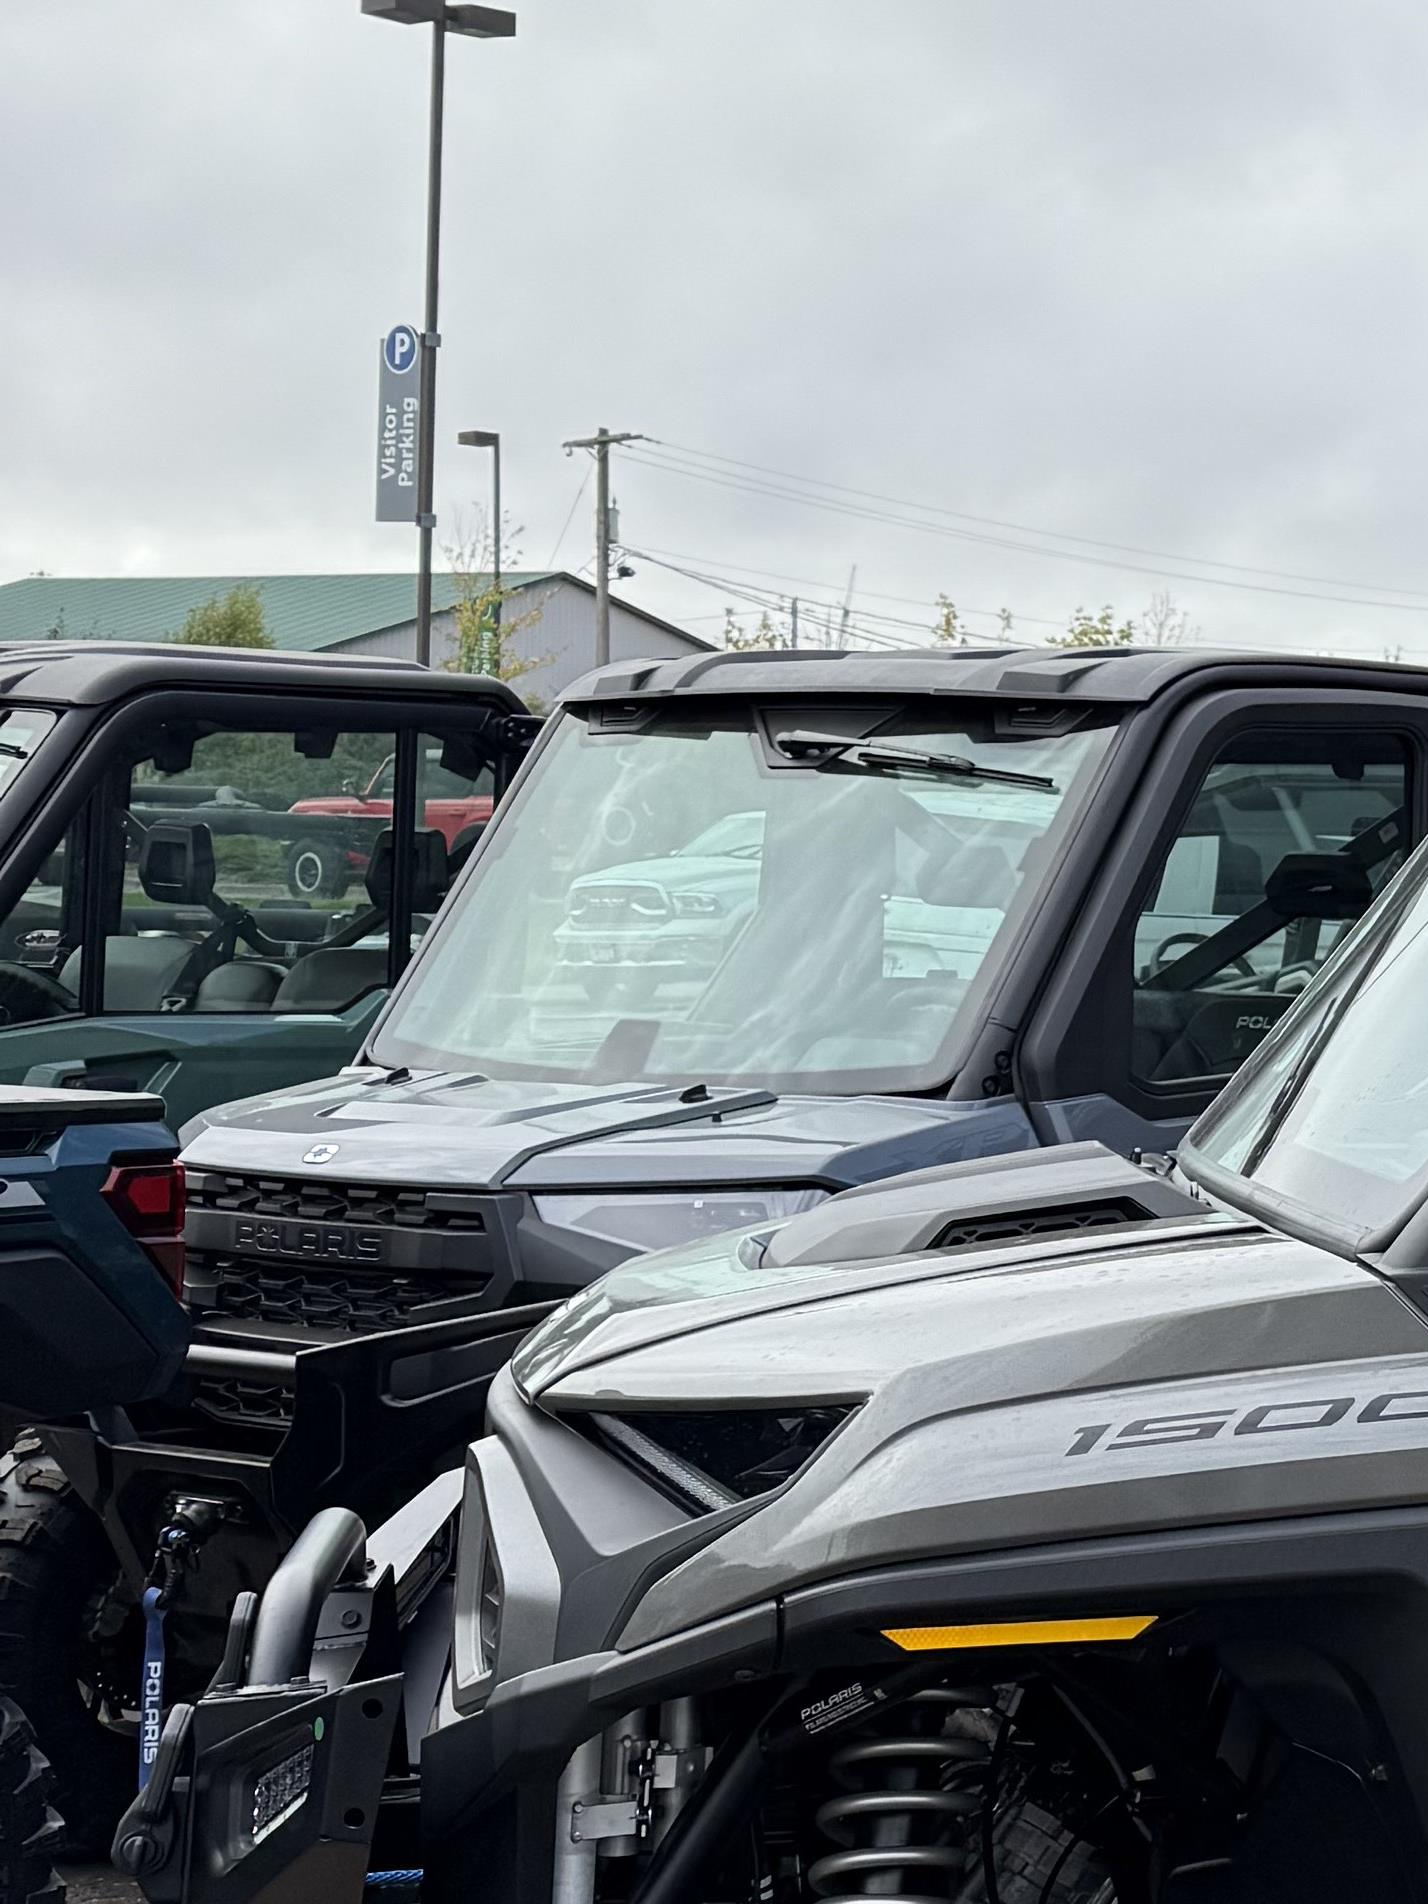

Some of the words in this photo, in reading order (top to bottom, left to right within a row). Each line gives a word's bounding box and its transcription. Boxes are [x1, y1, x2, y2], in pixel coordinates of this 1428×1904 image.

[394, 332, 411, 365] P
[380, 403, 398, 480] Visitor
[398, 396, 419, 487] Parking
[234, 1225, 384, 1261] POLARIS
[143, 1661, 162, 1764] POLARIS
[800, 1682, 863, 1720] POLARIS
